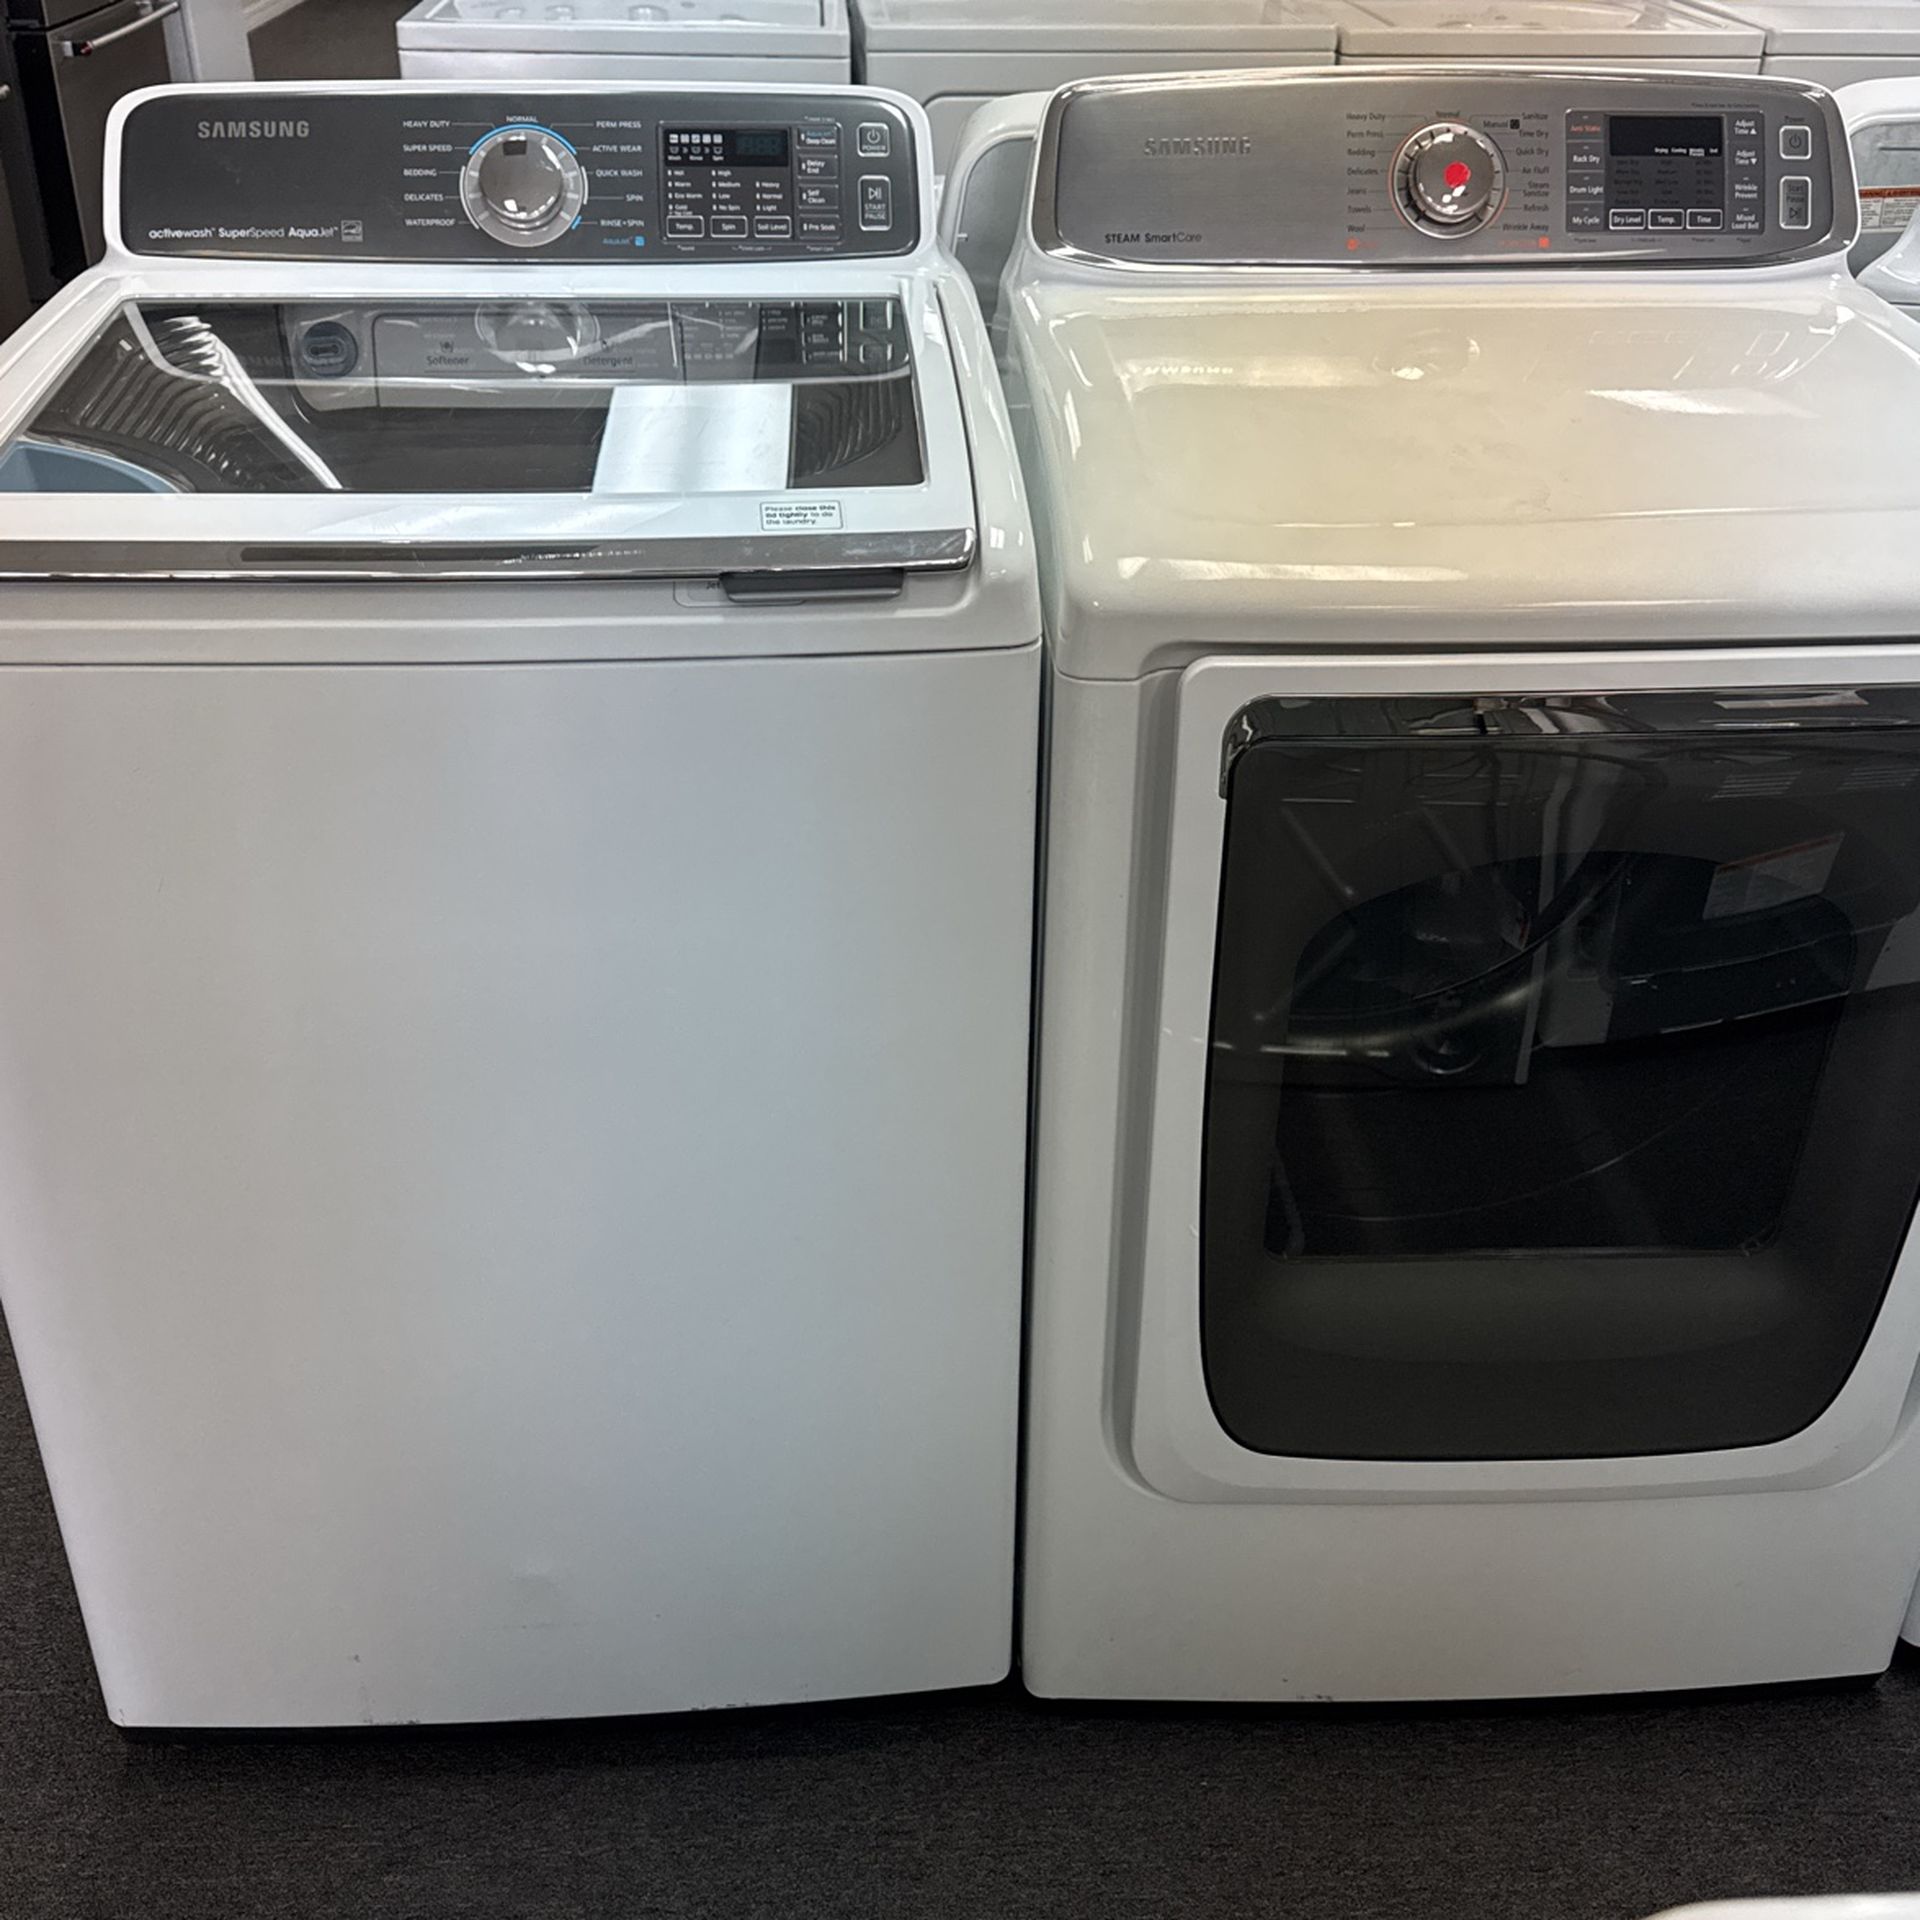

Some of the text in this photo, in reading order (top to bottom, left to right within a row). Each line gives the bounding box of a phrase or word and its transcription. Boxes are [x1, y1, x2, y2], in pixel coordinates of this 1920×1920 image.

[596, 121, 642, 129] PERM PRESS
[198, 120, 310, 139] SAMSUNG
[1144, 137, 1251, 156] SAMSUNG
[1589, 155, 1600, 164] Dry
[807, 160, 826, 168] Delay
[596, 169, 643, 177] QUICK WASH
[1569, 186, 1586, 194] Drum
[626, 194, 644, 202] SPIN
[405, 219, 456, 227] WATERPROOF
[1613, 216, 1625, 224] Dry
[218, 227, 285, 240] SuperSpeed
[1105, 232, 1203, 244] STEAM SmartCare
[426, 354, 470, 367] Softener
